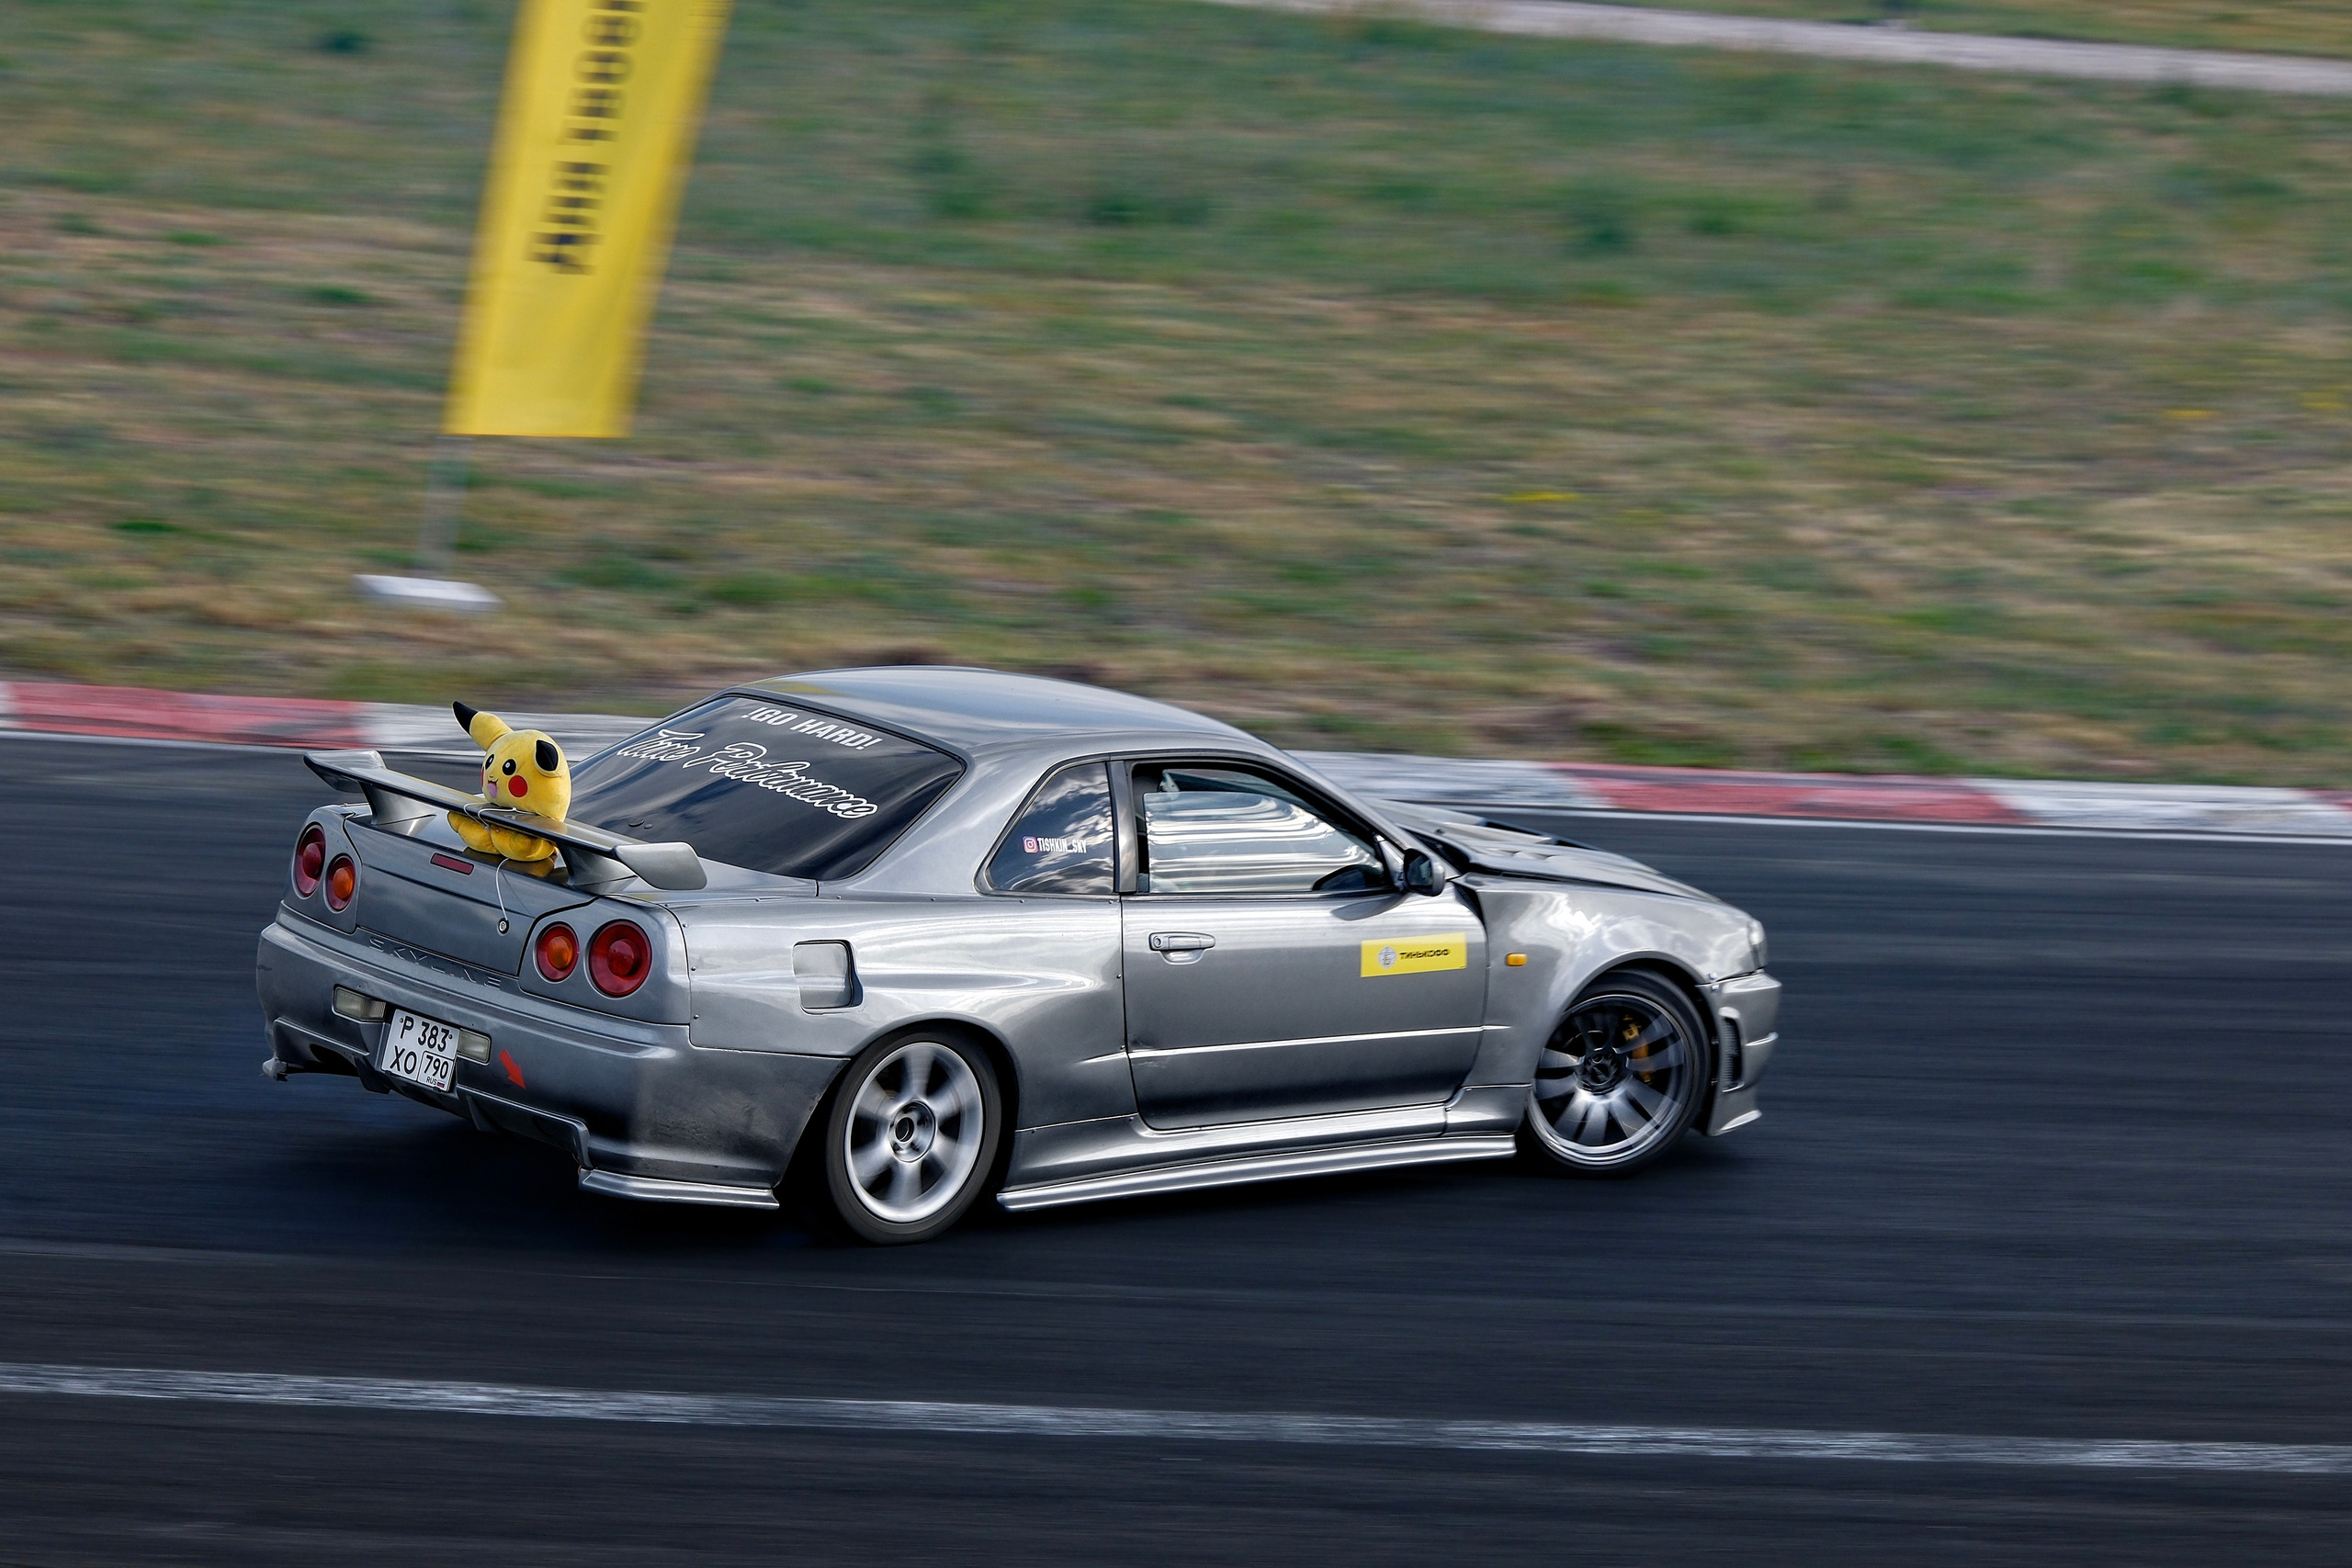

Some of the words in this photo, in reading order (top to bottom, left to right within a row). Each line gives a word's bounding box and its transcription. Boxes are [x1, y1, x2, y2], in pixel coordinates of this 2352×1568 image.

[741, 706, 798, 727] !GO
[789, 718, 883, 750] HARD!
[682, 741, 879, 819] Performance
[1036, 837, 1088, 854] TISHKIN_SKY
[417, 1021, 451, 1053] 383
[424, 1055, 450, 1080] 790
[425, 1076, 438, 1087] RUS
